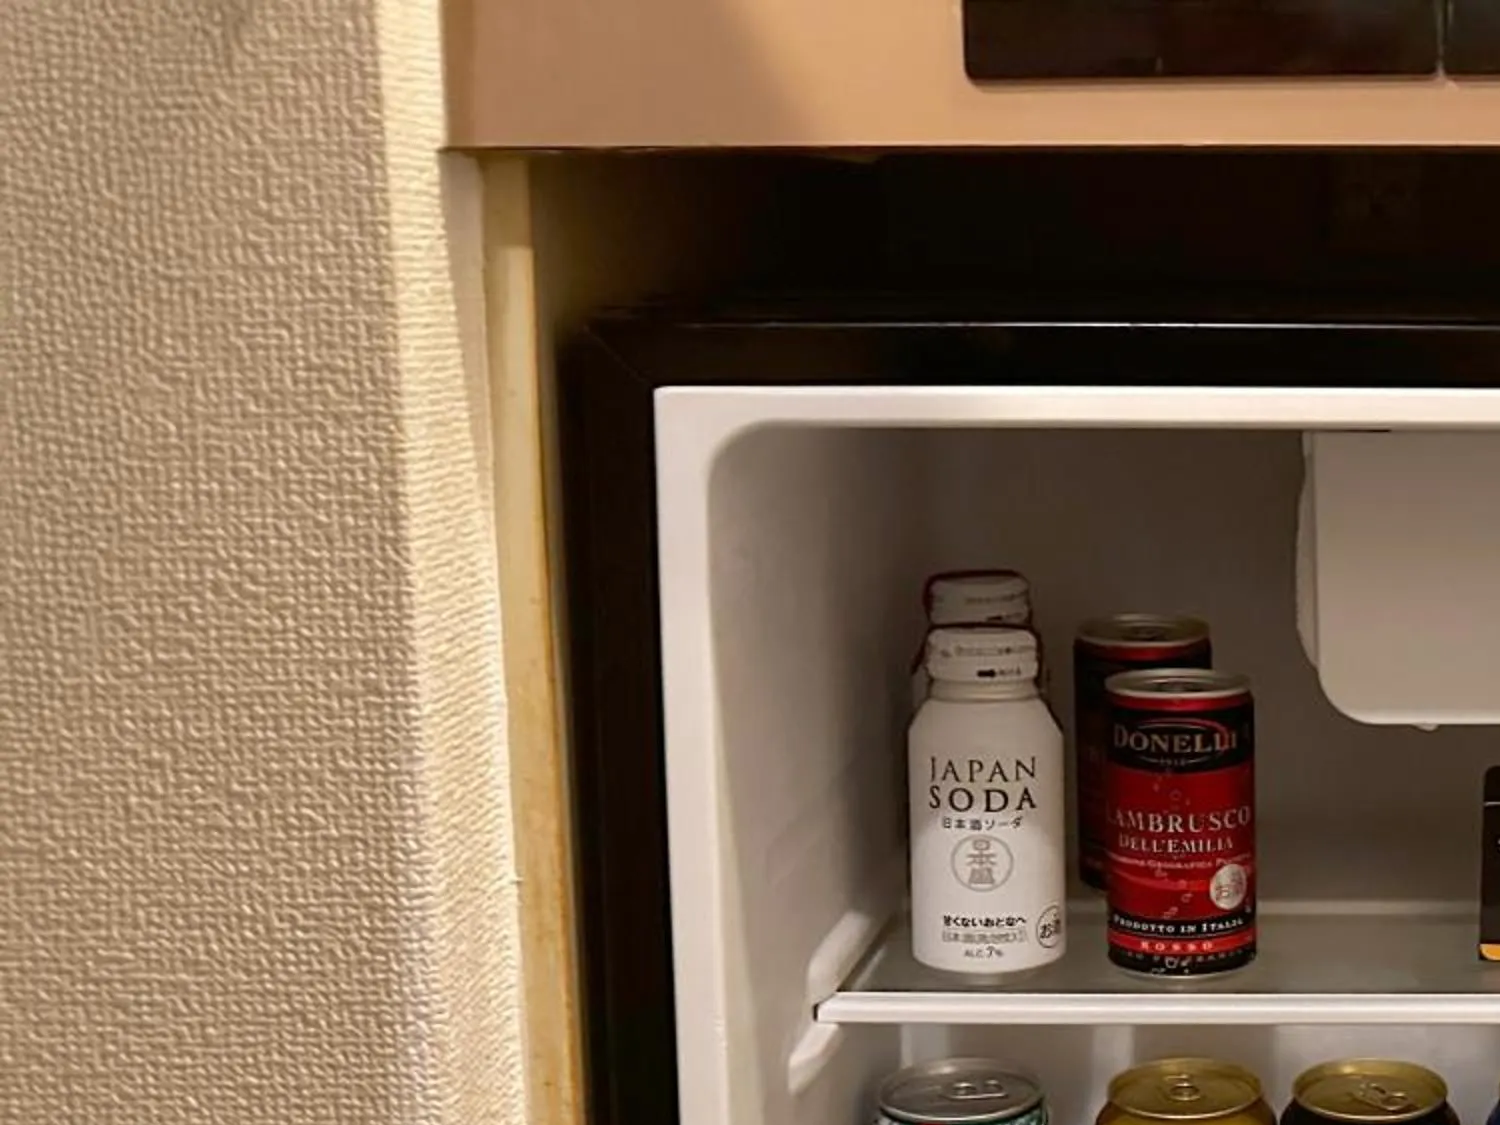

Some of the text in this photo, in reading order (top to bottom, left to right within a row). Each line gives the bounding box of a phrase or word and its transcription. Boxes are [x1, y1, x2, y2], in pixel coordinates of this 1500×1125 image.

[1114, 723, 1237, 753] DONELLI
[930, 756, 1036, 783] JAPAN
[928, 785, 1037, 813] SODA
[1118, 834, 1234, 853] DELL'EMILIA
